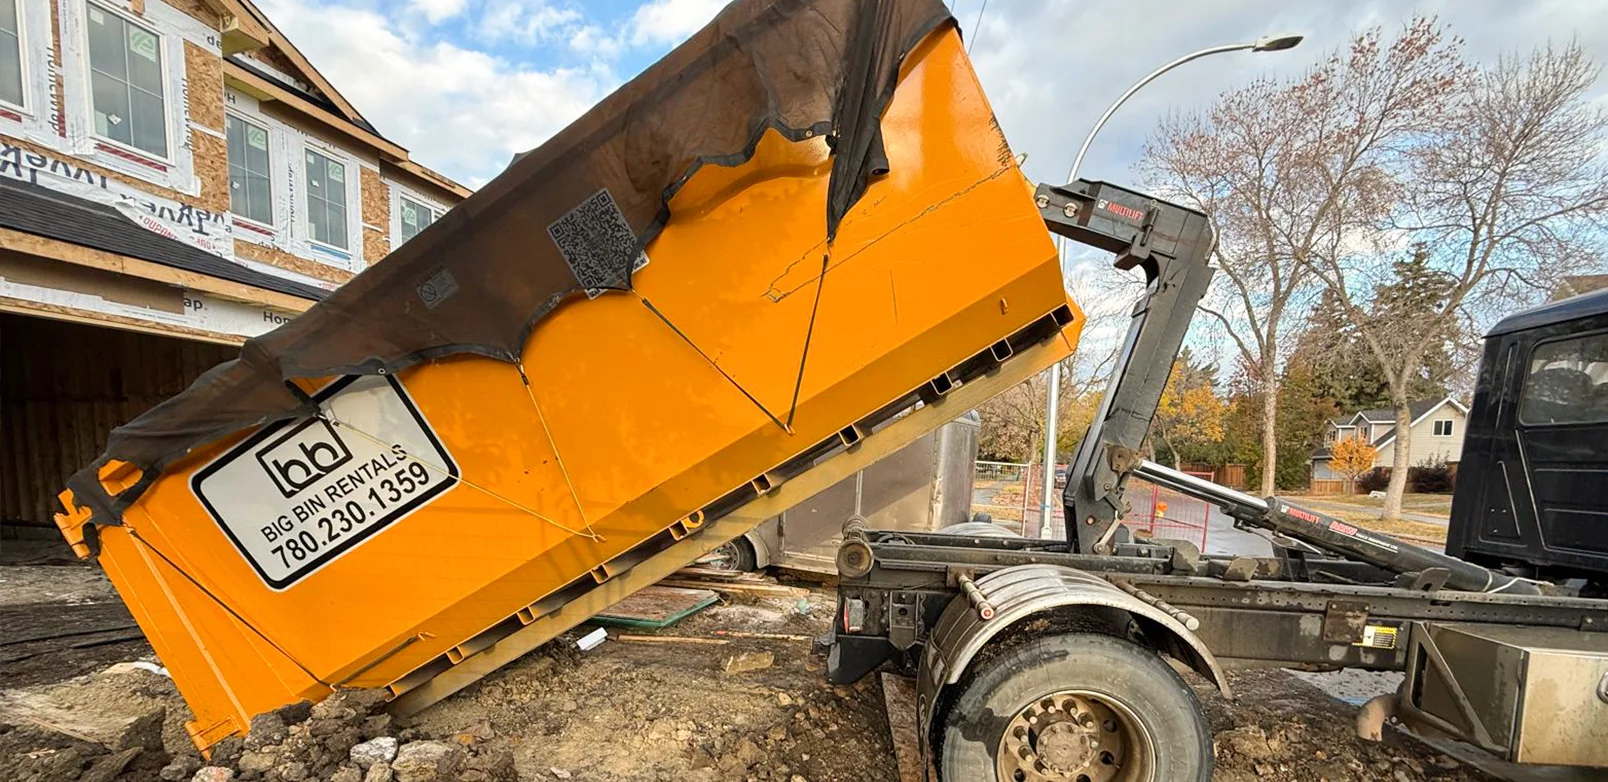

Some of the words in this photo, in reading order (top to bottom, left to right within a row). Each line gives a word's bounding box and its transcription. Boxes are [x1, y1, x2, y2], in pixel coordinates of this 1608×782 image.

[1107, 201, 1144, 221] MULTILIFT
[261, 515, 294, 543] BIG
[292, 494, 325, 522] BIN
[323, 443, 407, 503] RENTALS
[271, 461, 430, 569] 780.230.1359
